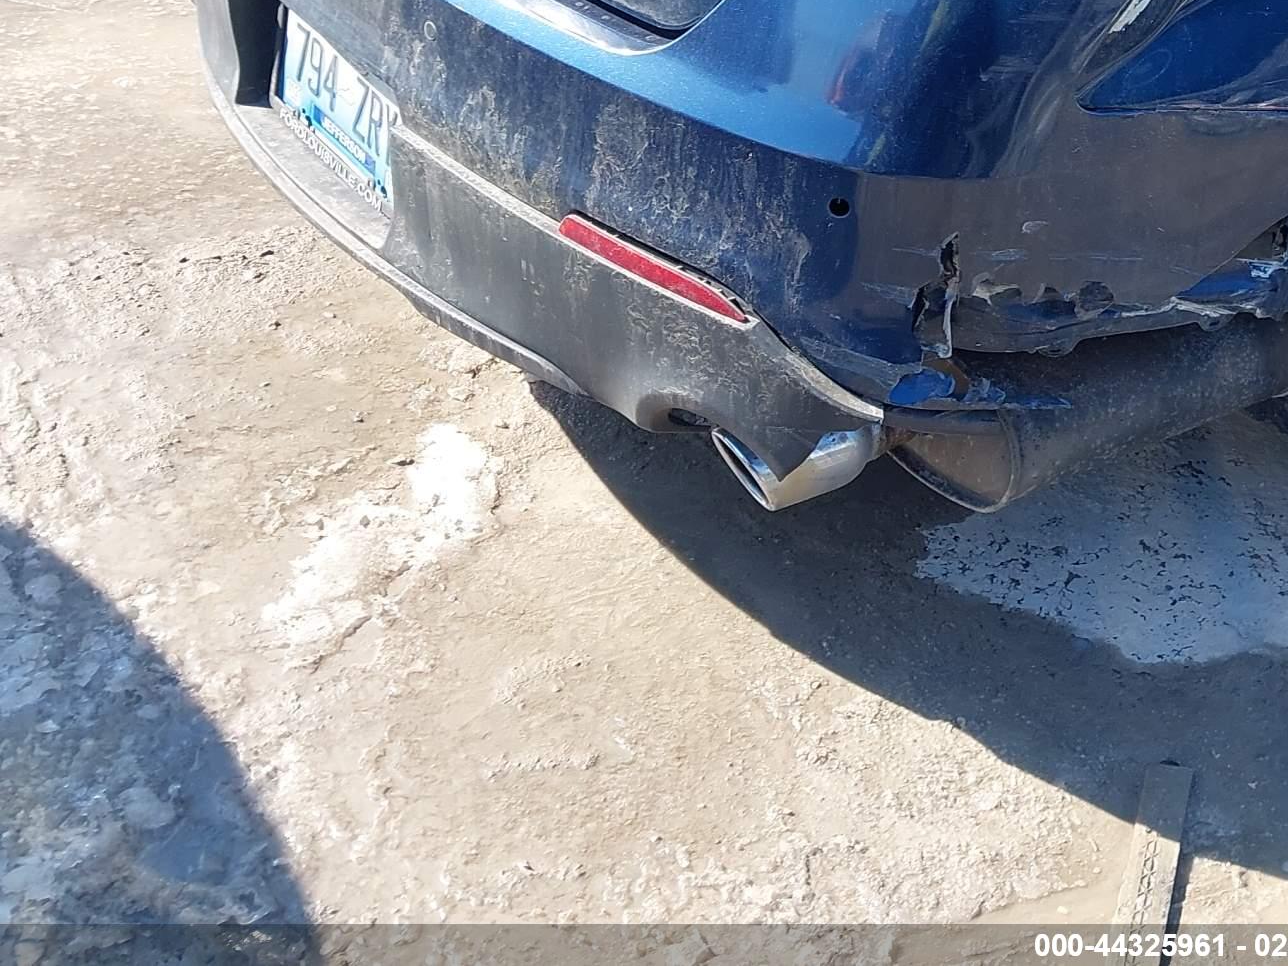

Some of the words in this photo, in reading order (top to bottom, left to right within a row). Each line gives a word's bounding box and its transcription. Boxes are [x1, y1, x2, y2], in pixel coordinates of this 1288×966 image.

[297, 22, 338, 112] 794
[279, 109, 383, 211] FORDLOUISVILLE.COM
[321, 117, 366, 165] JEFFERSON
